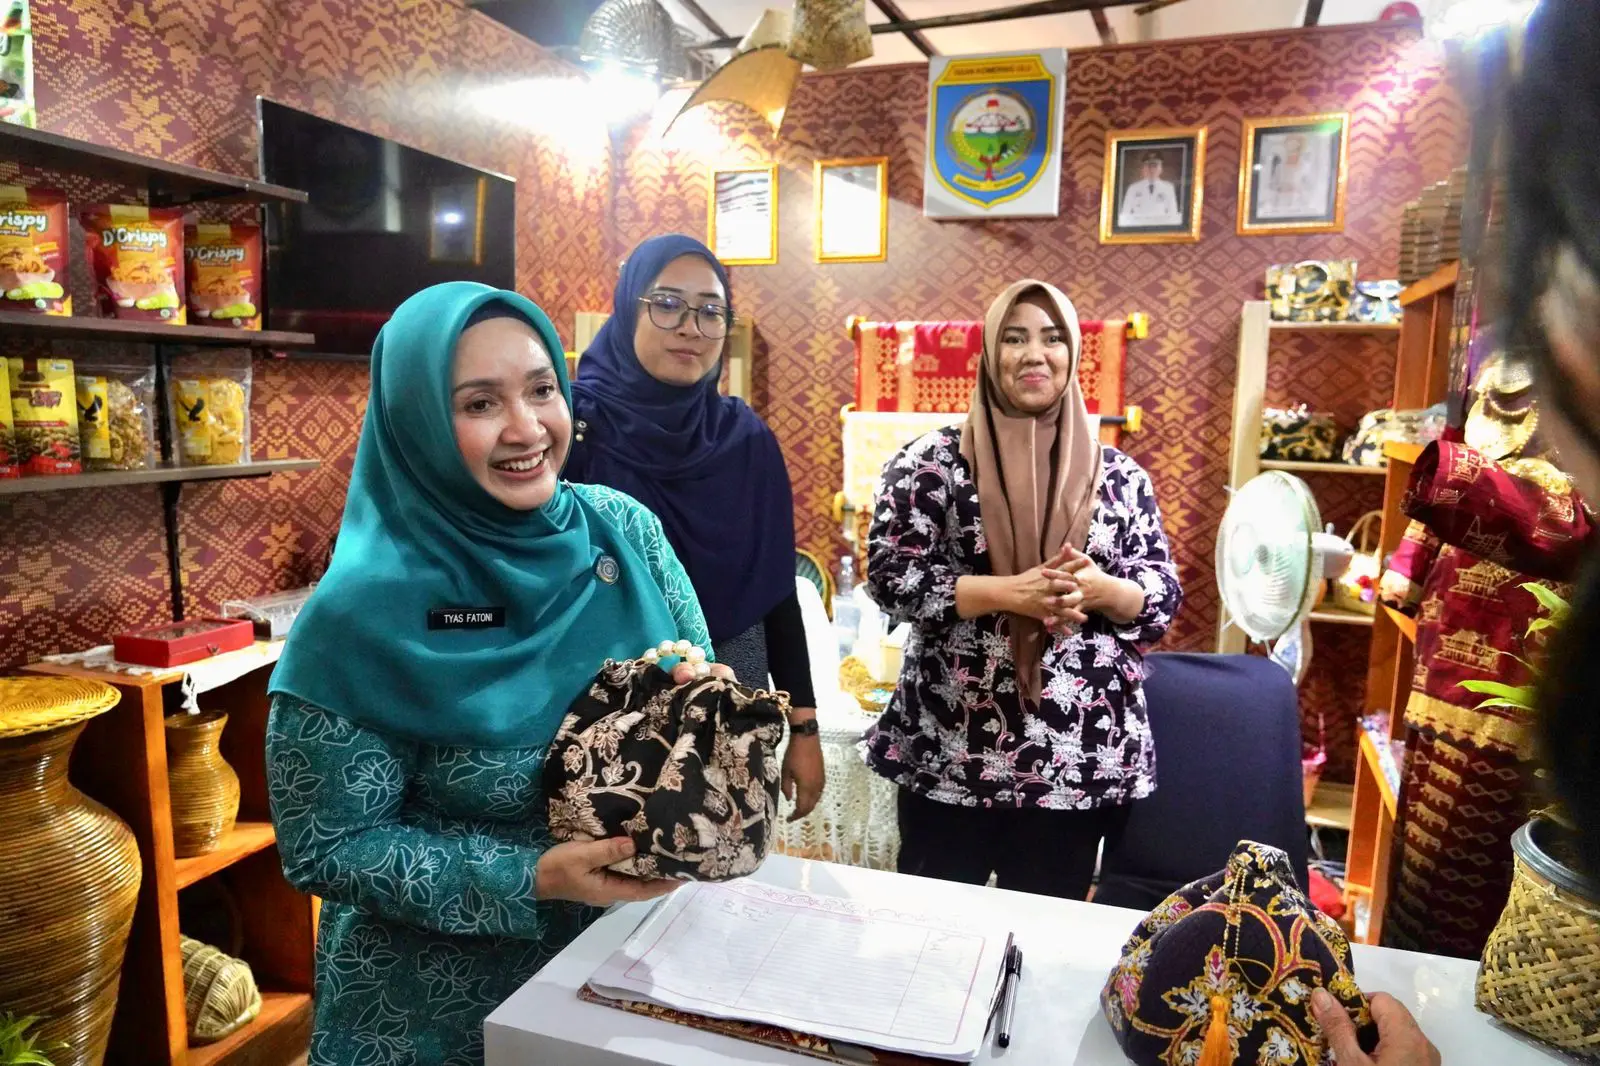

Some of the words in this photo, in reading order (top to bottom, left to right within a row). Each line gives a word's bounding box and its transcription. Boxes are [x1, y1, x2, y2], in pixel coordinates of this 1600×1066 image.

[102, 228, 167, 248] D'Crispy
[444, 614, 464, 623] TYAS
[466, 613, 493, 623] FATONI
